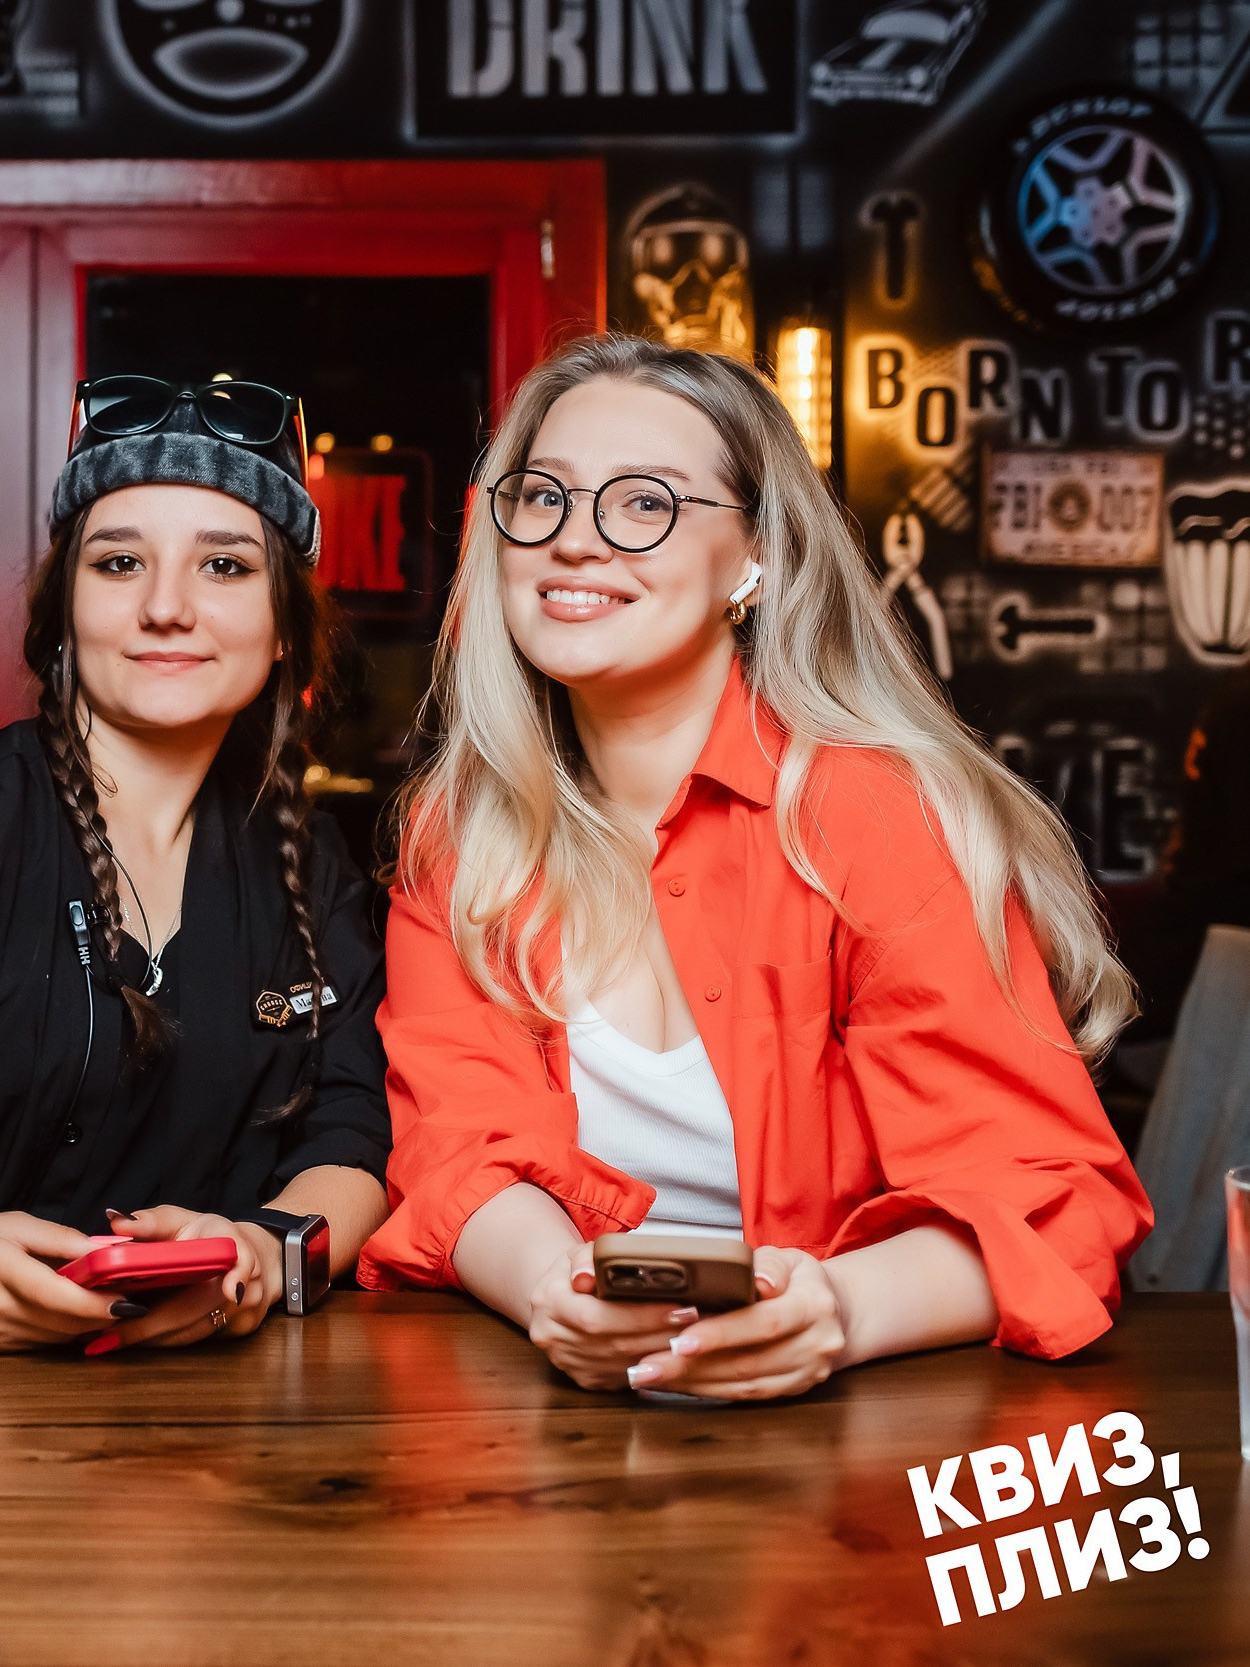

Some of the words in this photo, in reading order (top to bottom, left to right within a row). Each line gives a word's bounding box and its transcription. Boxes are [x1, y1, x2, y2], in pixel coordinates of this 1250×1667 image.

[448, 0, 768, 98] DRINK
[867, 348, 1063, 448] BORN
[1097, 355, 1180, 431] TO
